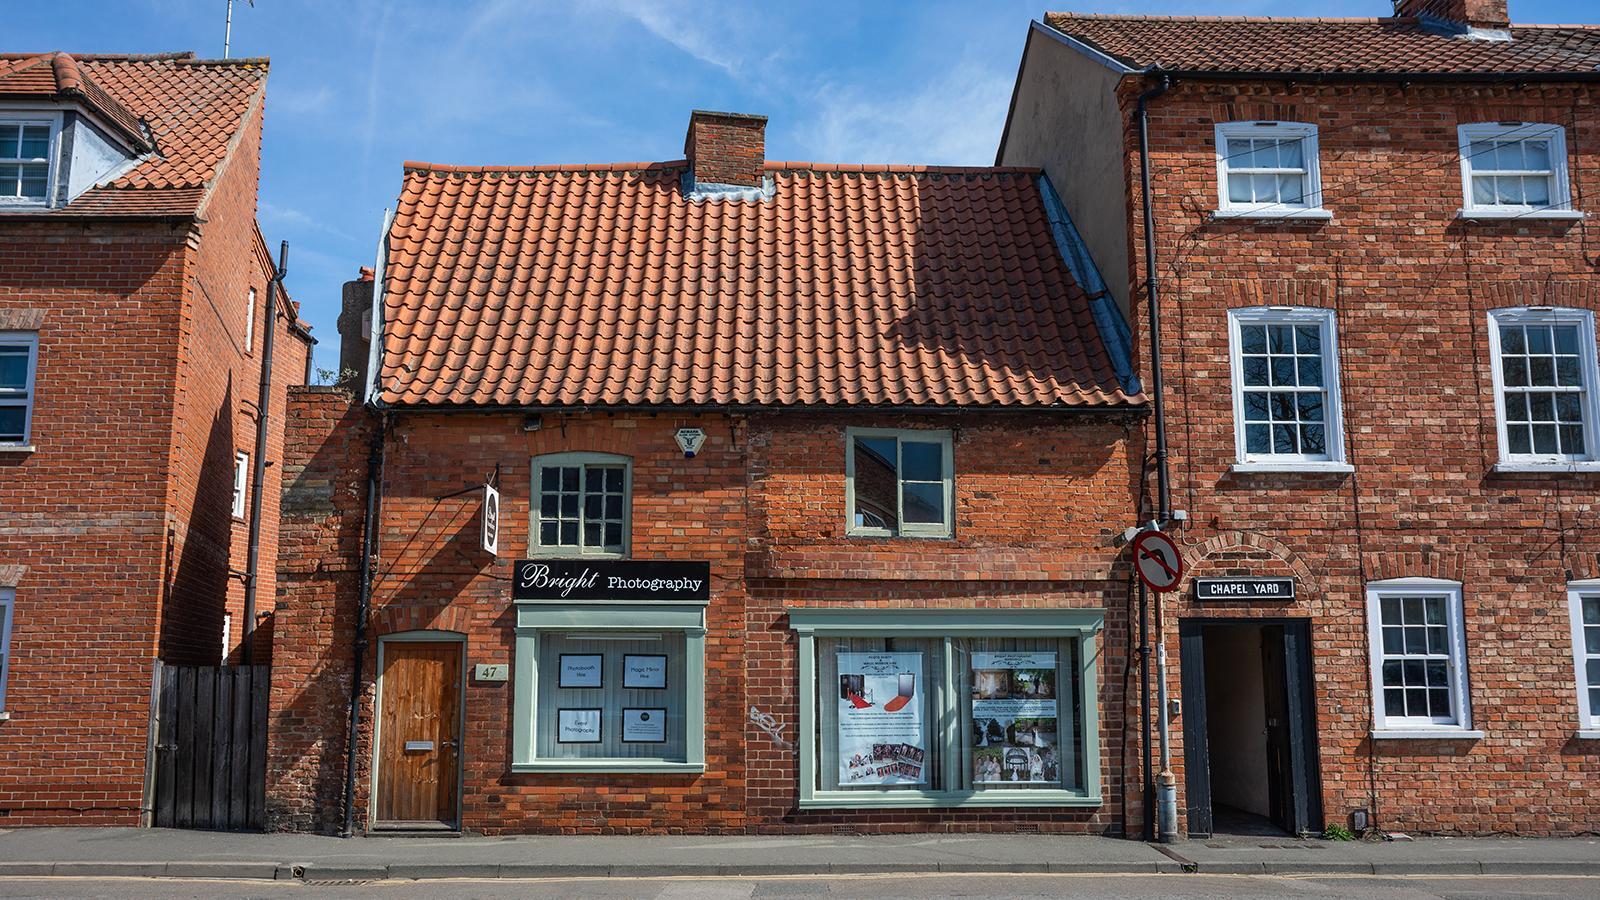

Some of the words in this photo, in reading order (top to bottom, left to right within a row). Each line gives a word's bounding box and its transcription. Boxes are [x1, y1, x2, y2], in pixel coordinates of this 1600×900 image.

[521, 563, 599, 597] Bright
[607, 576, 702, 591] Photography
[1210, 583, 1248, 594] CHAPEL
[1253, 583, 1279, 594] YARD
[482, 667, 497, 678] 47
